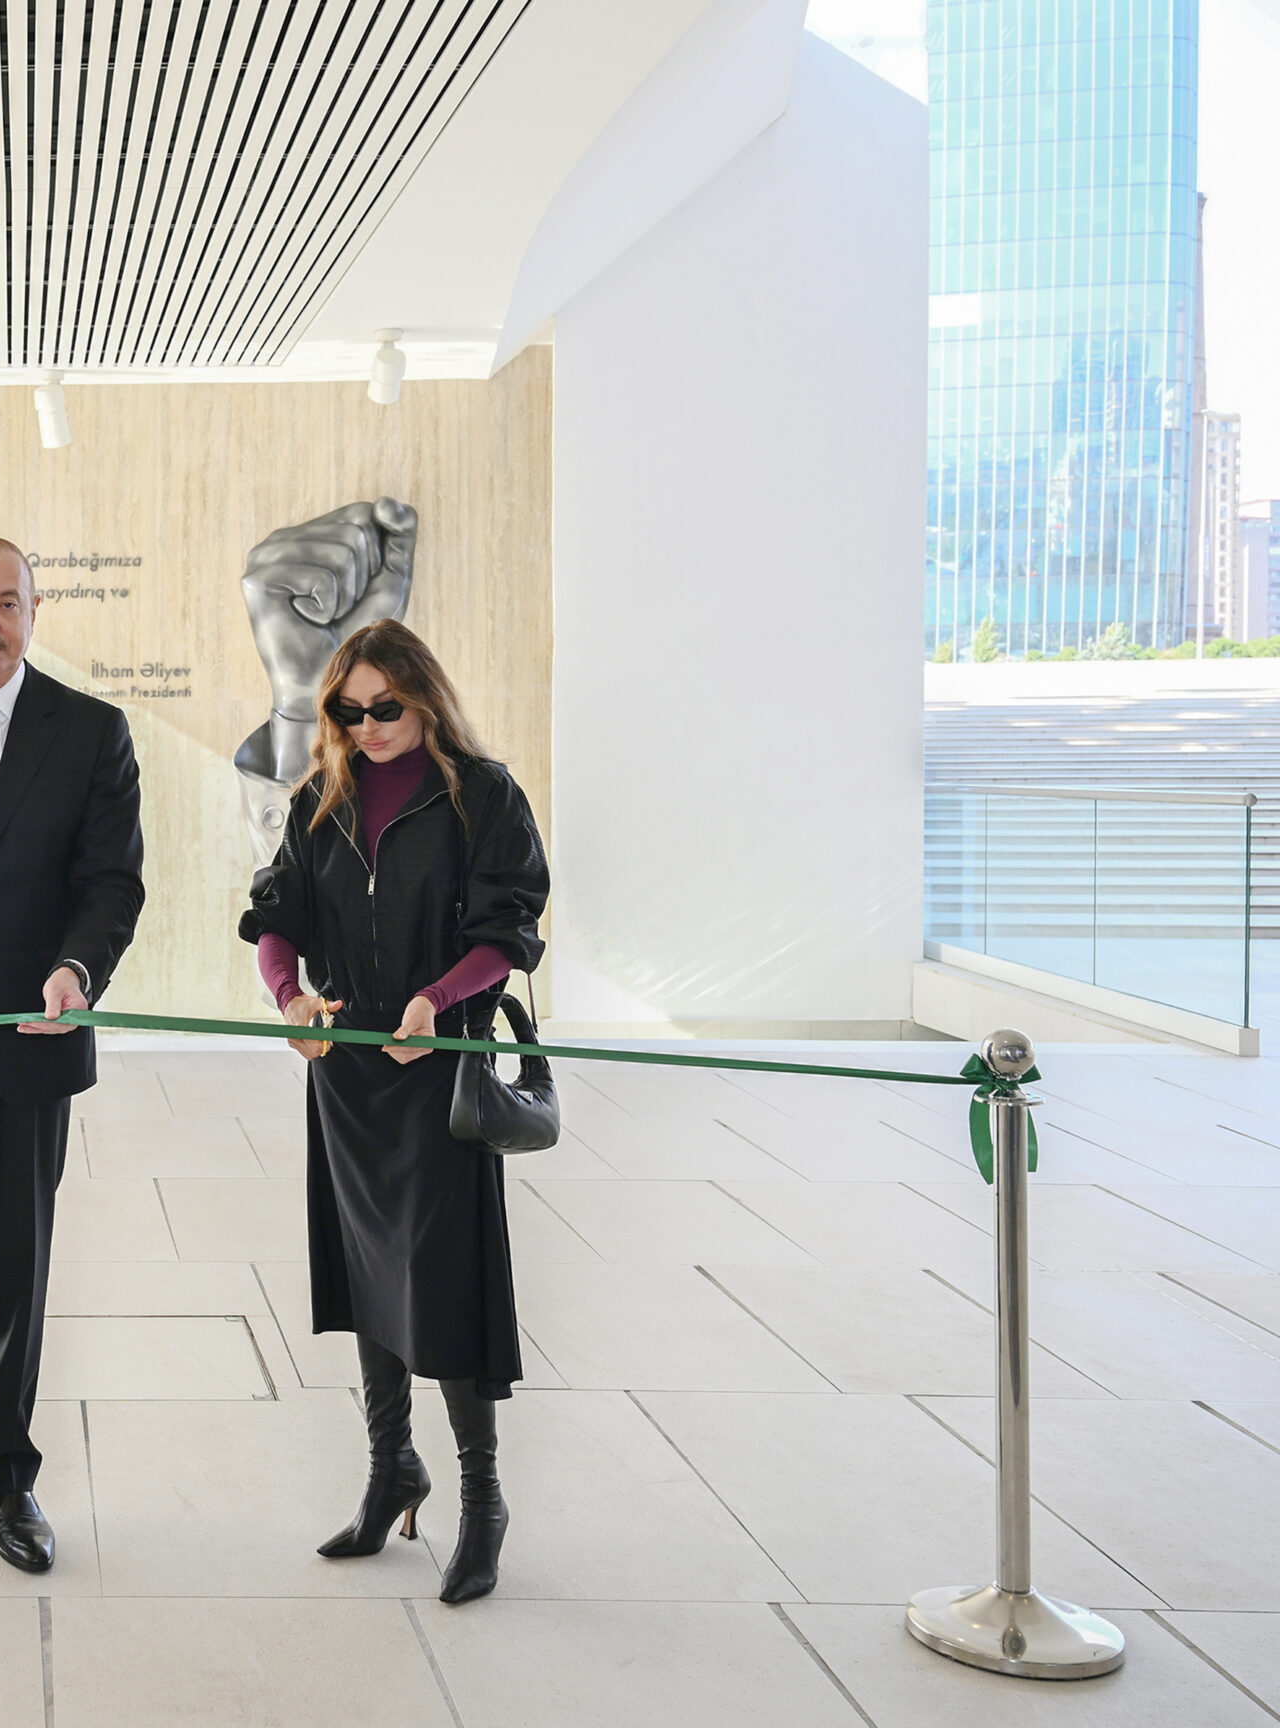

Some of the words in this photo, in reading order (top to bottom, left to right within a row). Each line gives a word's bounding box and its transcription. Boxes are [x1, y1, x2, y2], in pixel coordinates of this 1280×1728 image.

[26, 552, 143, 573] Qarabağımıza
[110, 588, 129, 599] və
[91, 657, 134, 679] İlham
[140, 661, 191, 683] Əliyev
[130, 685, 192, 699] Prezidenti
